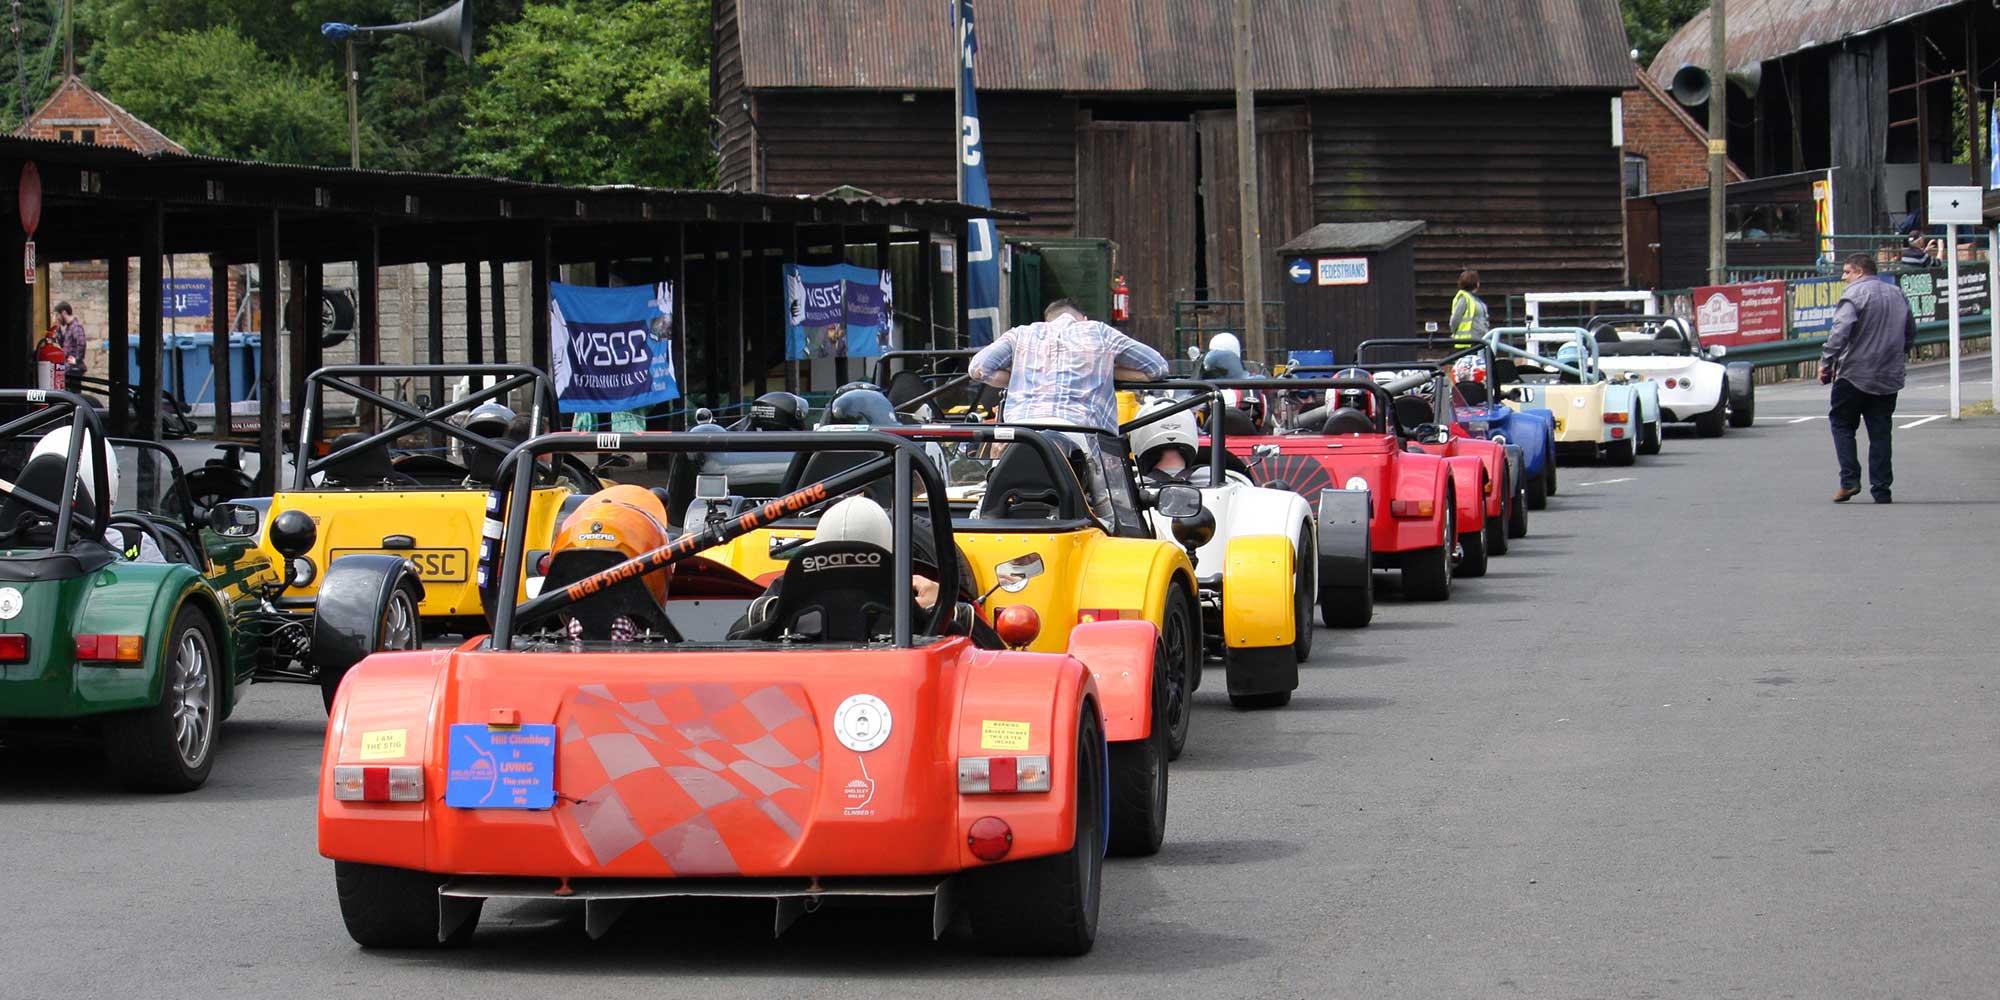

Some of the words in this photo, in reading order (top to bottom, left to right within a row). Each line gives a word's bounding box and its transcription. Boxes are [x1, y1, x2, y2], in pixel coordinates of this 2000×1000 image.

[1320, 263, 1366, 279] PEDESTRIANS
[1794, 282, 1815, 308] JOIN
[1816, 281, 1829, 307] US
[570, 329, 648, 366] WSCC
[567, 559, 645, 601] marshals
[764, 483, 828, 520] orange
[802, 552, 881, 572] sparco
[367, 743, 382, 751] THE
[383, 740, 402, 750] STIG
[491, 734, 508, 745] Hill
[509, 734, 551, 746] Climbing
[500, 762, 534, 773] LIVING
